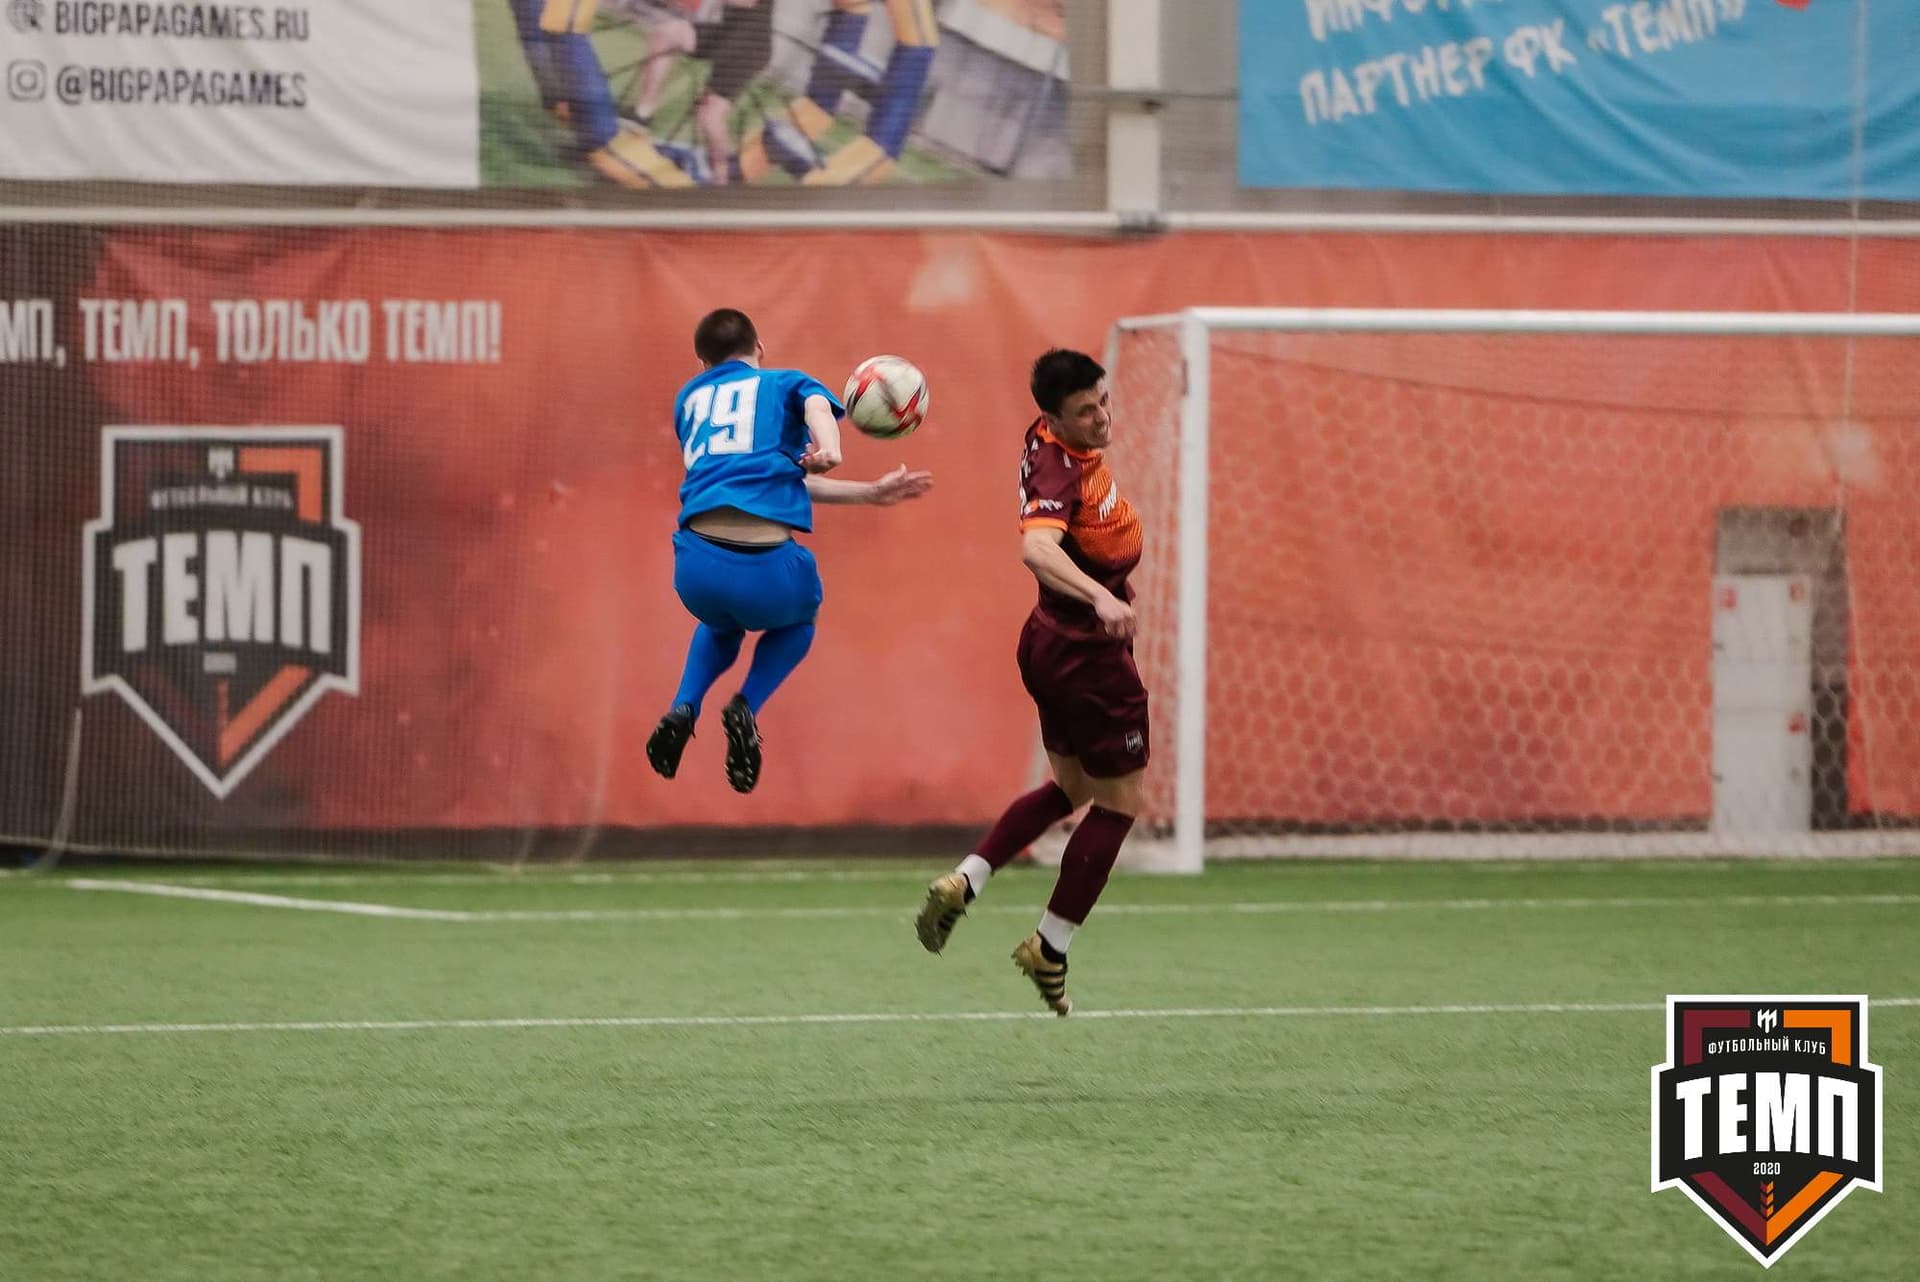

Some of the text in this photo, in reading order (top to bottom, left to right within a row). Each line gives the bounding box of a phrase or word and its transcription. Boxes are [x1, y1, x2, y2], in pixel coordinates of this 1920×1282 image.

[55, 0, 310, 41] BIGPAPAGAMES.RU
[56, 64, 307, 106] @BIGPAPAGAMES
[1300, 36, 1493, 126] ПАРТНЕР
[1503, 16, 1578, 79] ФК
[79, 298, 199, 370] ТЕМП,
[211, 299, 371, 364] ТОЛЬКО
[383, 300, 501, 363] ТЕМП!
[683, 376, 760, 471] 29
[112, 529, 332, 655] ТЕМП
